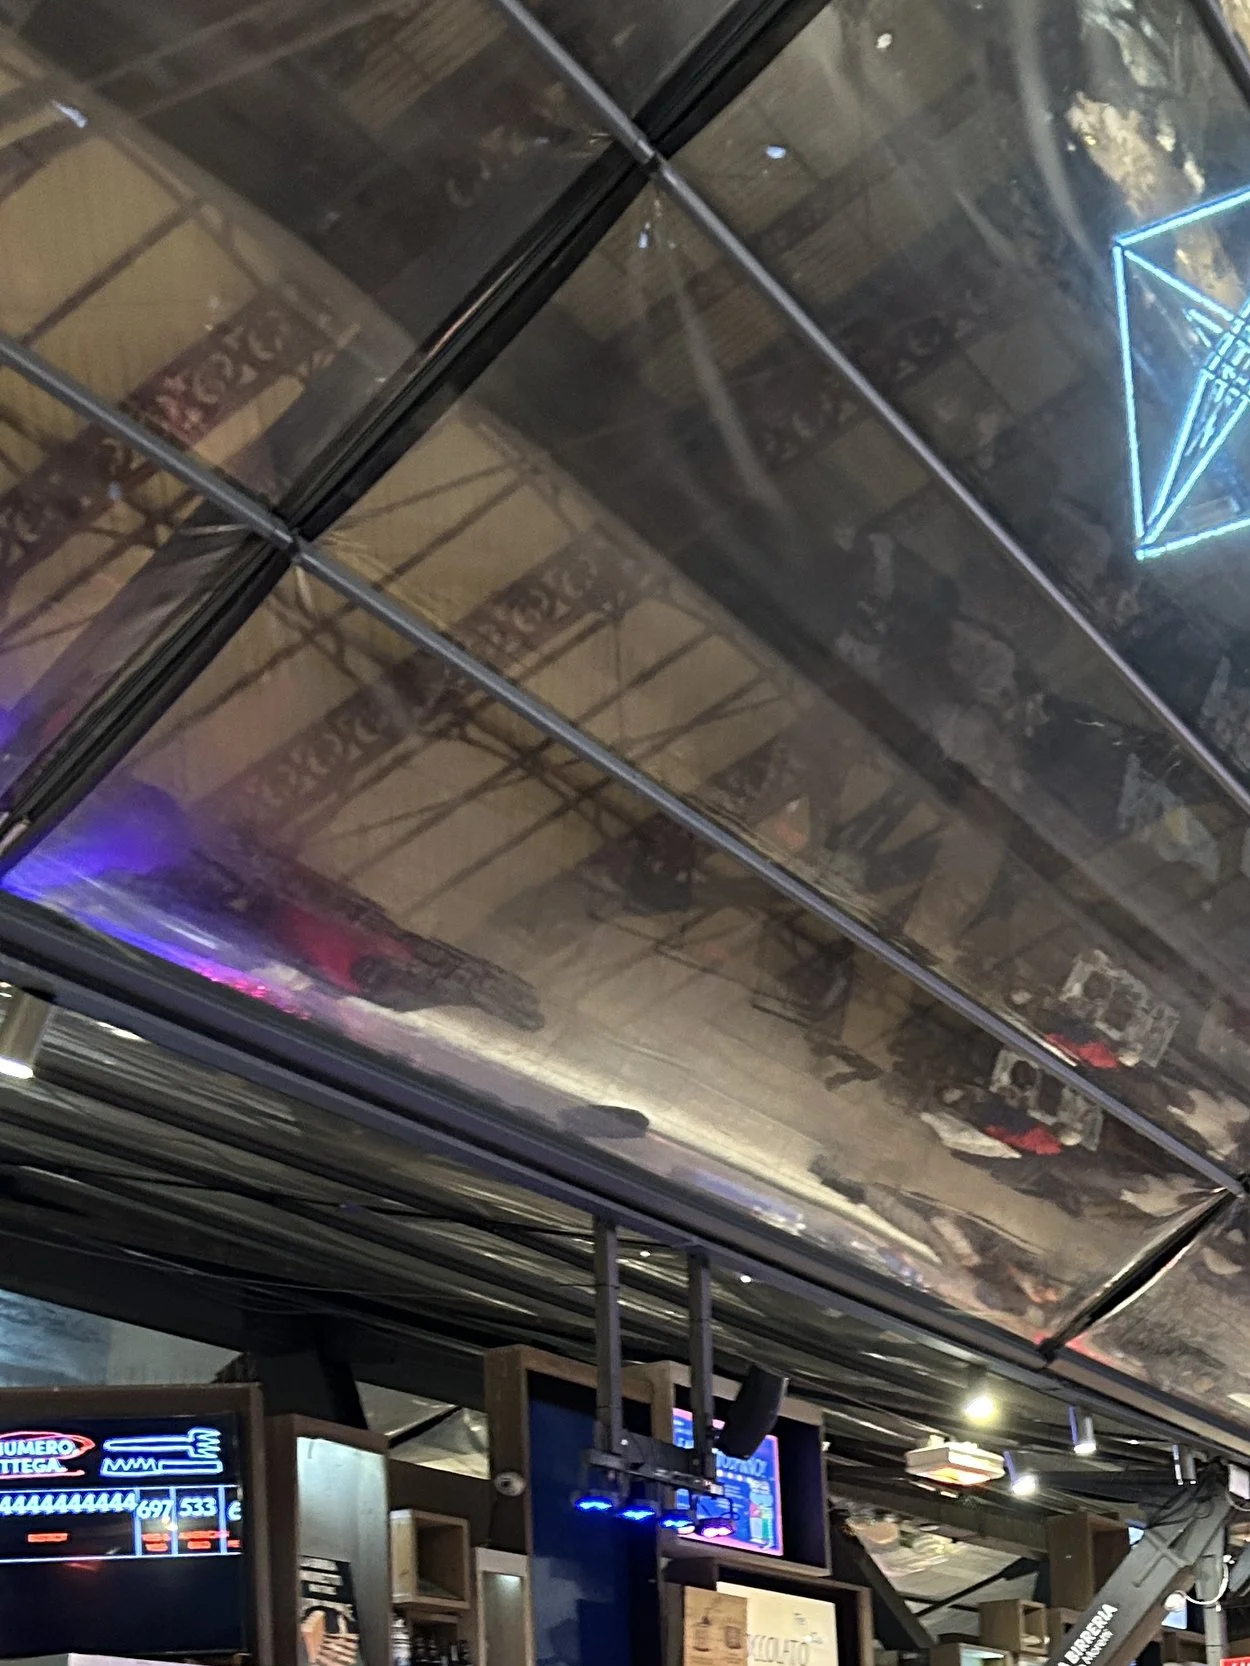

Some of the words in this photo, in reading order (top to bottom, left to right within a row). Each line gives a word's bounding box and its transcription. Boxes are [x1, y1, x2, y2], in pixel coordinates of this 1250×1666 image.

[0, 1440, 74, 1456] UMERO
[136, 1500, 175, 1519] 697
[179, 1497, 217, 1516] 533
[1064, 1603, 1119, 1665] BIRRERIA
